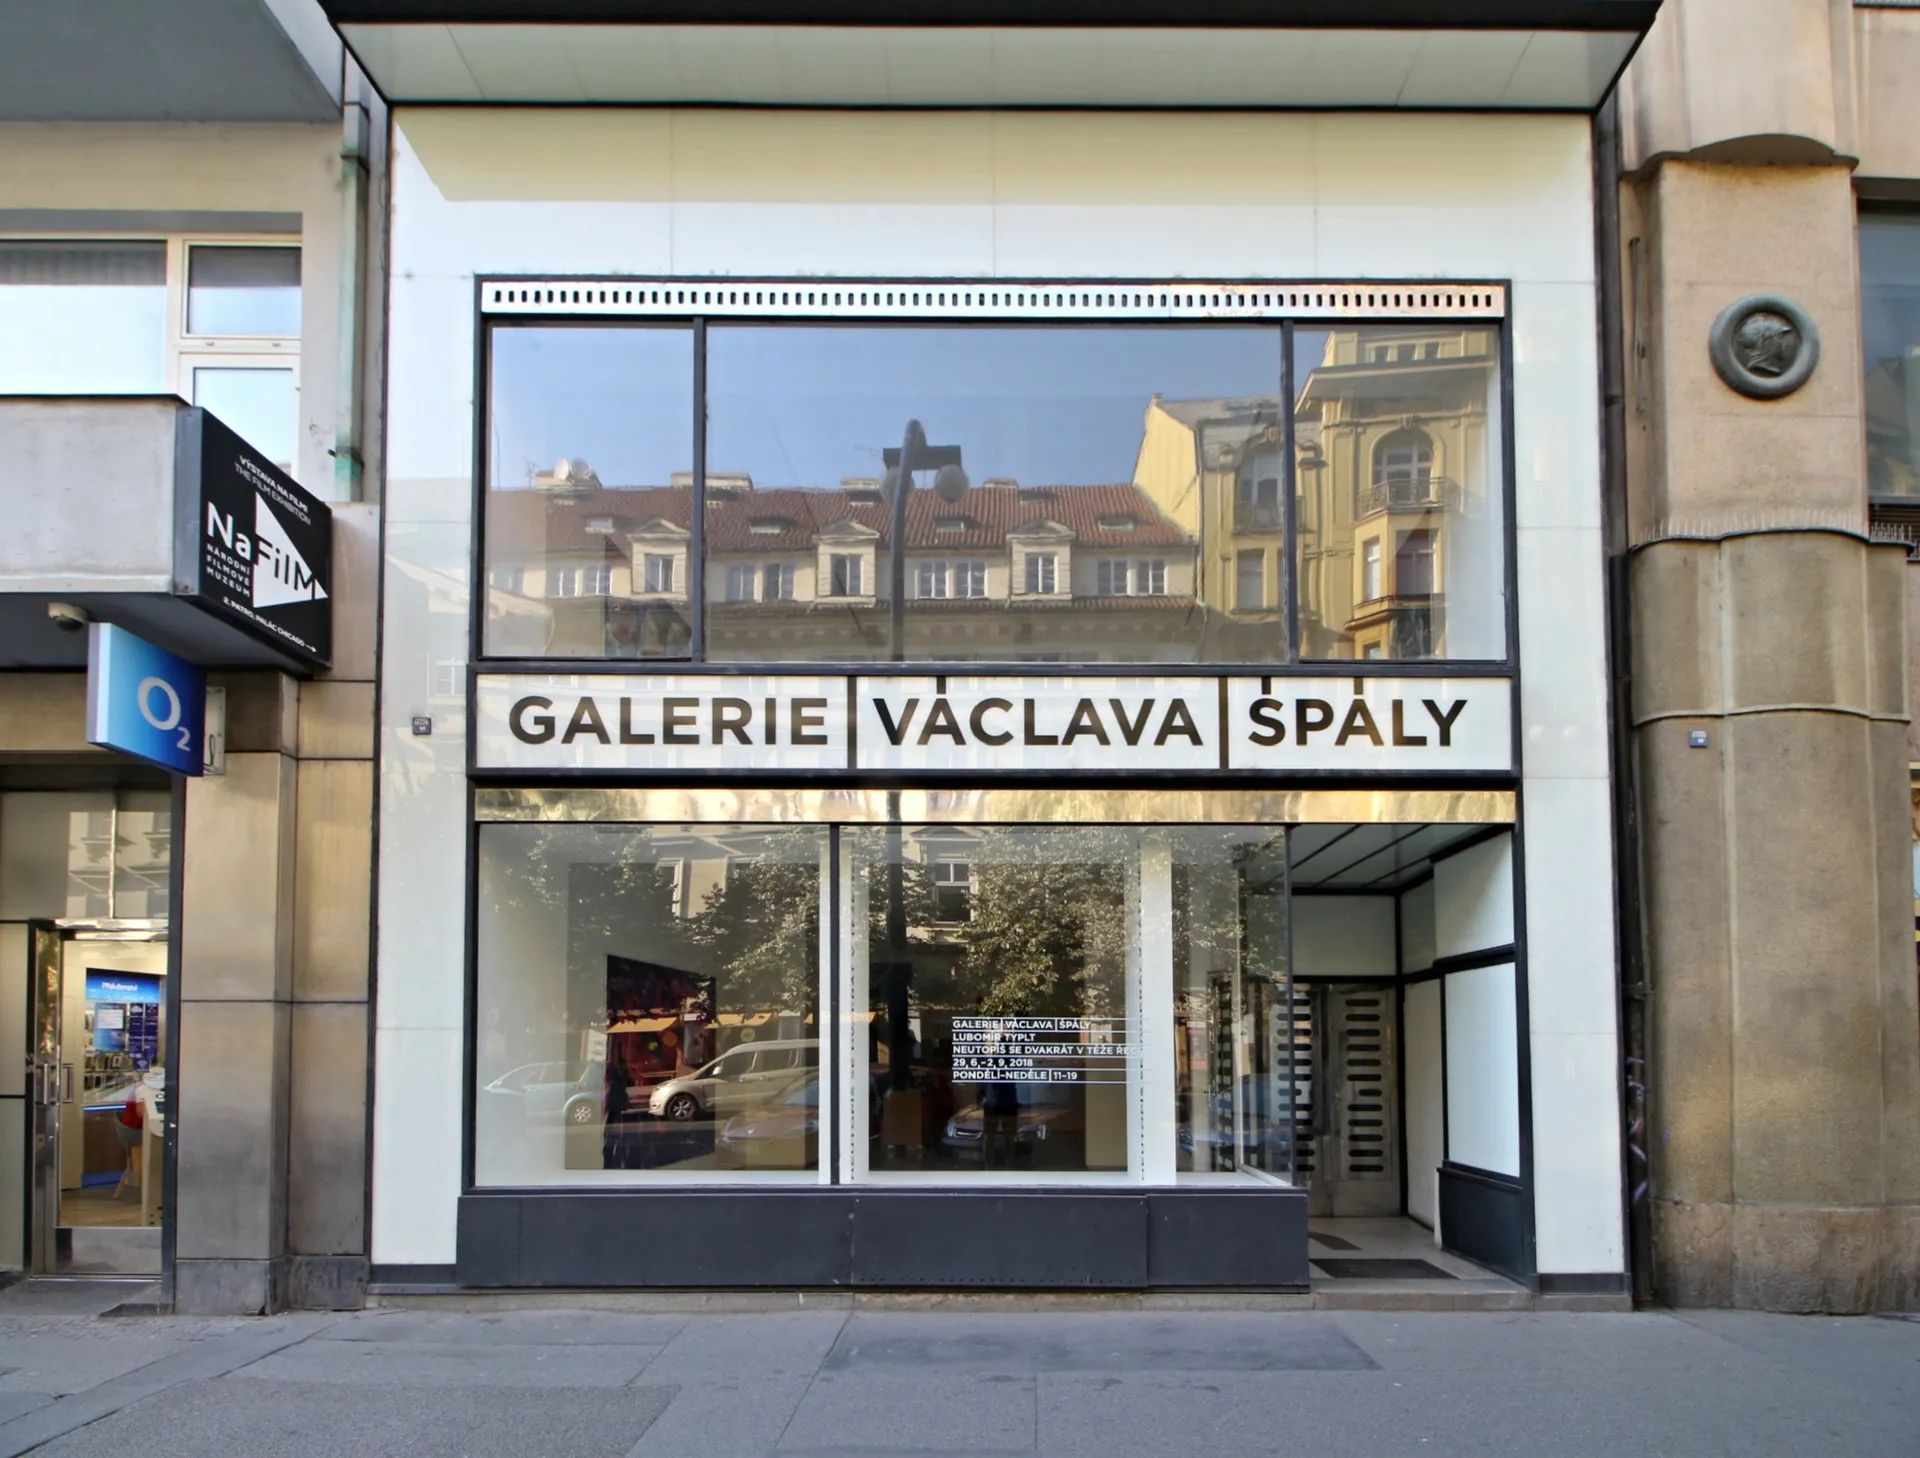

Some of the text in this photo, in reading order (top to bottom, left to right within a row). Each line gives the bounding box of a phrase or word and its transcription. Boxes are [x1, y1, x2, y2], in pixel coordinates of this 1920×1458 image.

[207, 543, 250, 576] NÁRODNÍ
[207, 554, 250, 587] FILMOVÉ
[207, 566, 250, 597] MUZEUM
[137, 676, 191, 751] O2
[509, 695, 829, 746] GALERIE
[952, 1020, 999, 1029] GALERIE
[1003, 1033, 1036, 1042] TYPLT
[1008, 1046, 1022, 1054] SE
[1076, 1046, 1084, 1055] V
[1009, 1058, 1034, 1067] 2018
